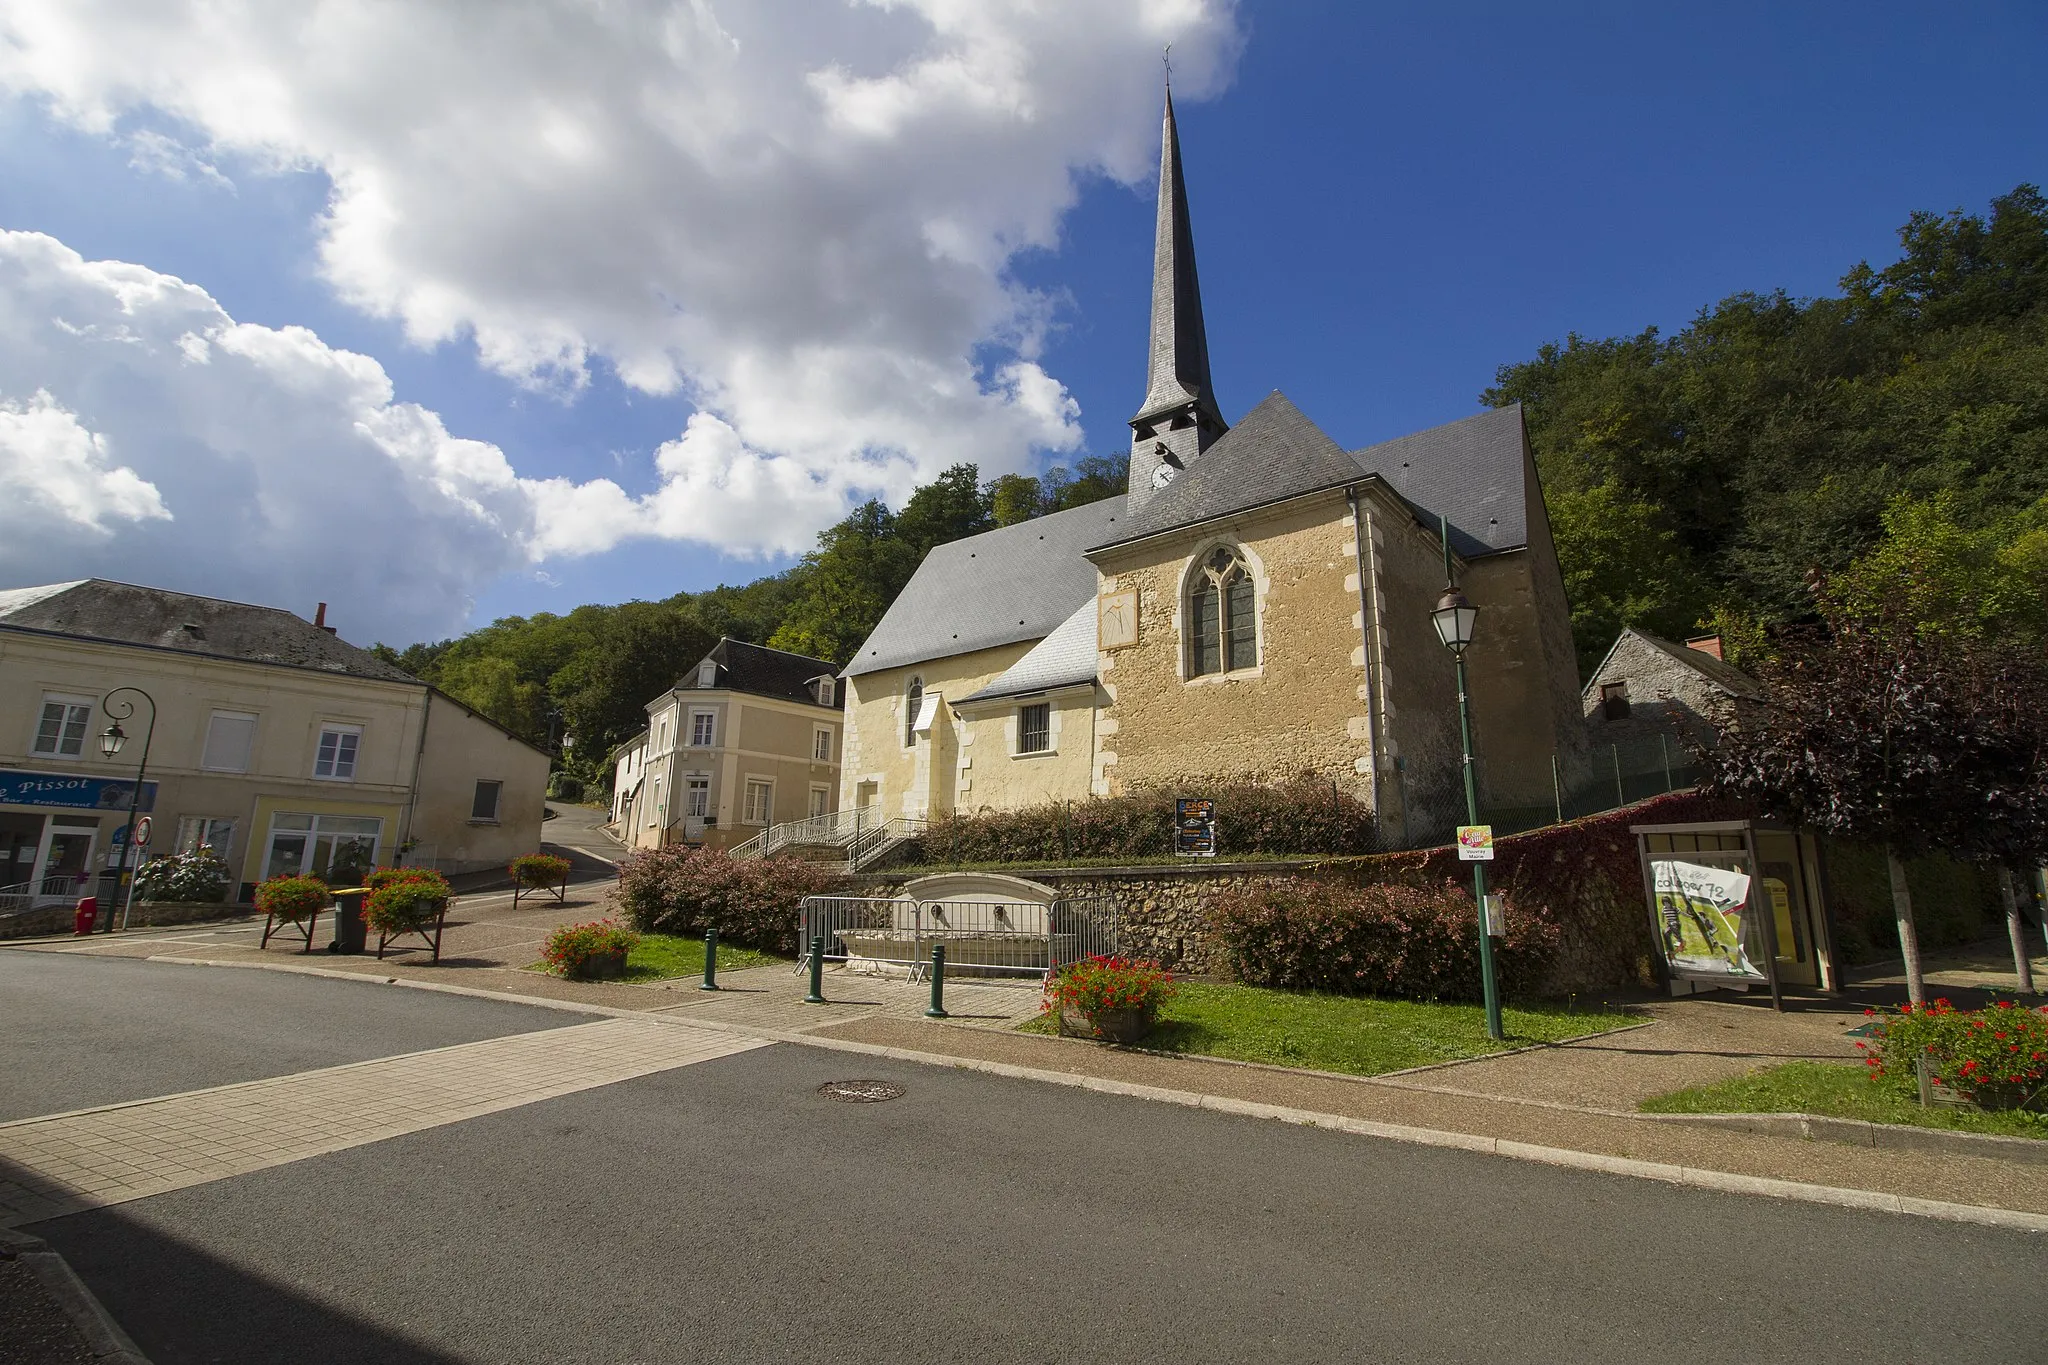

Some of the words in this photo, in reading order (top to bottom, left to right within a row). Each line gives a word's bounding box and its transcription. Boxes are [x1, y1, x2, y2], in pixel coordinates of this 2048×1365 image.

[18, 778, 89, 793] Pissot
[32, 799, 92, 808] Restaurant
[1705, 883, 1724, 898] 72
